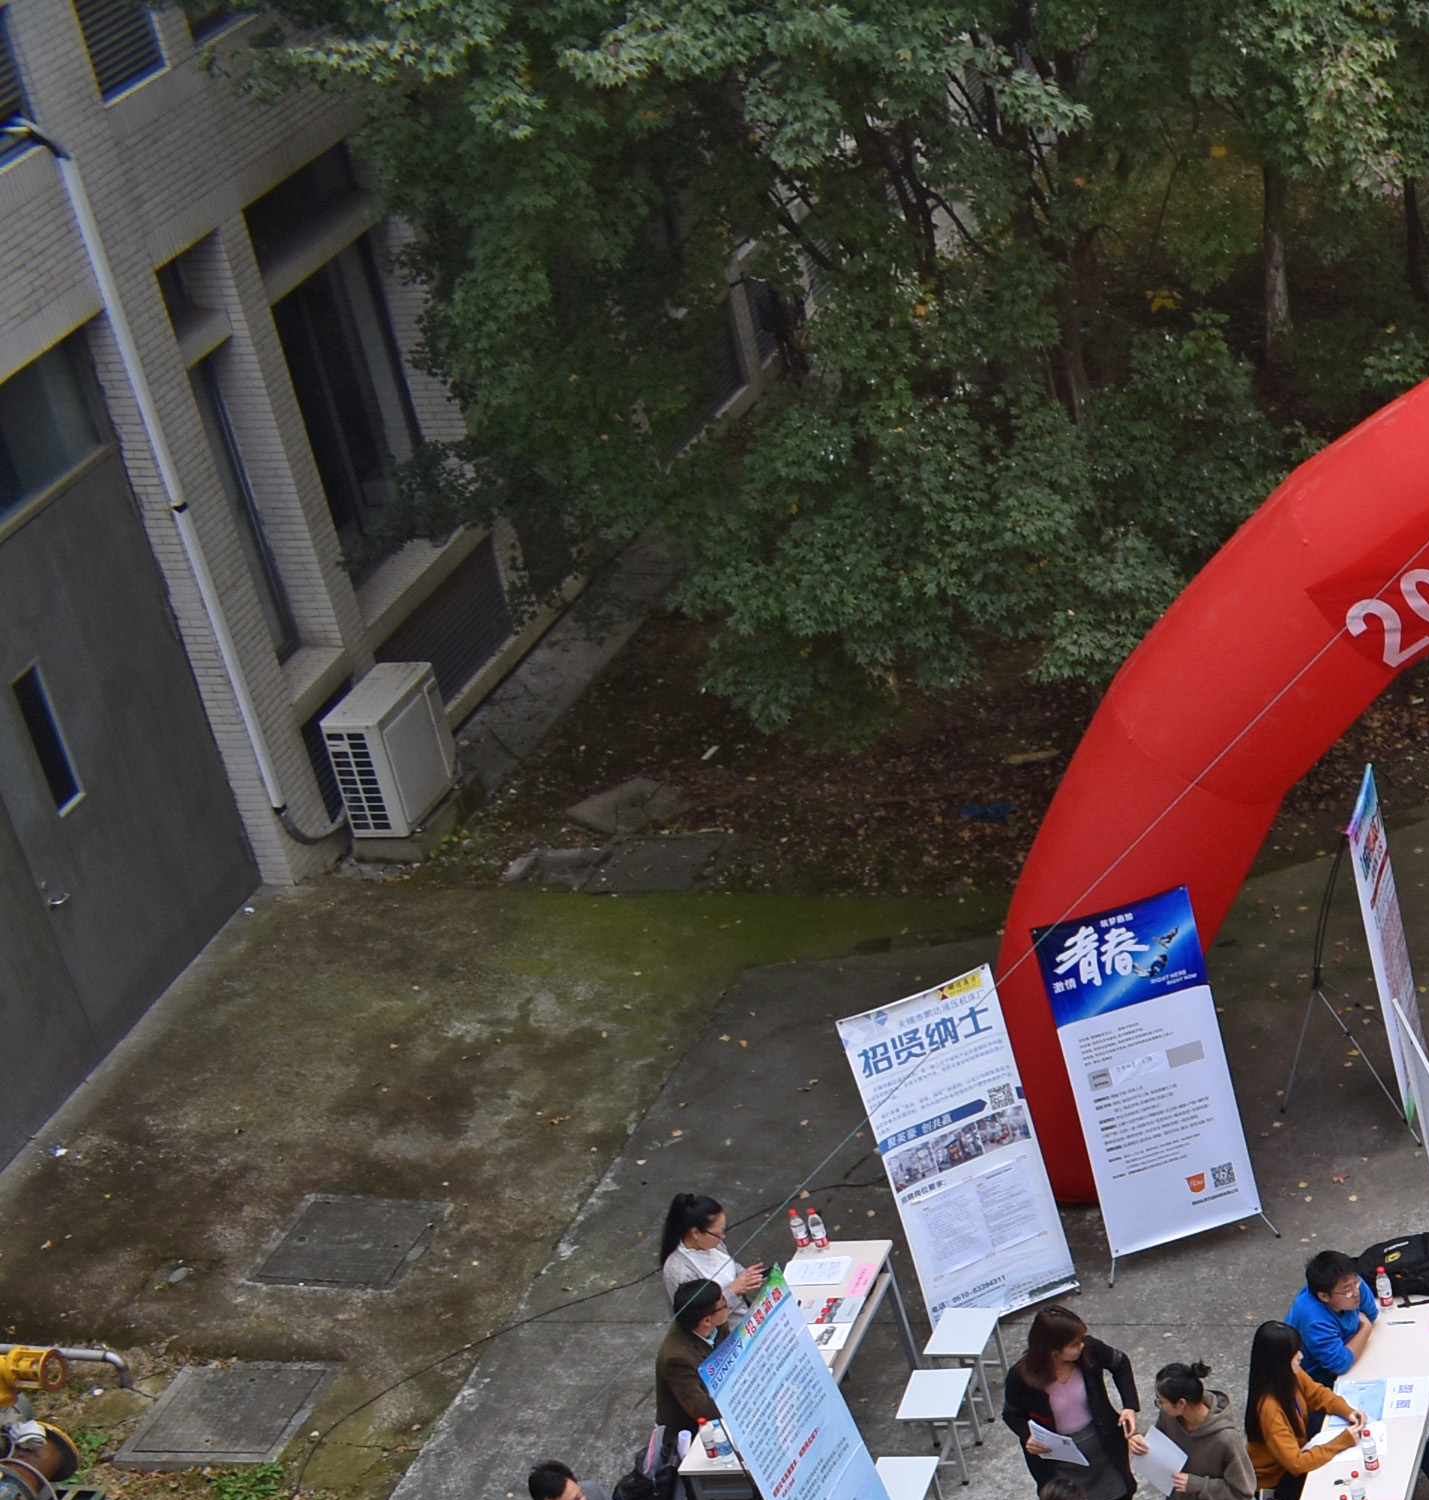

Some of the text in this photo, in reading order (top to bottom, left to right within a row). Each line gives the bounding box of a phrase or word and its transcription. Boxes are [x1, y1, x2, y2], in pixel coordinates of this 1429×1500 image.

[1053, 924, 1149, 987] 青春
[857, 1005, 994, 1080] 招贤纳士
[711, 1340, 746, 1391] SUNKEY
